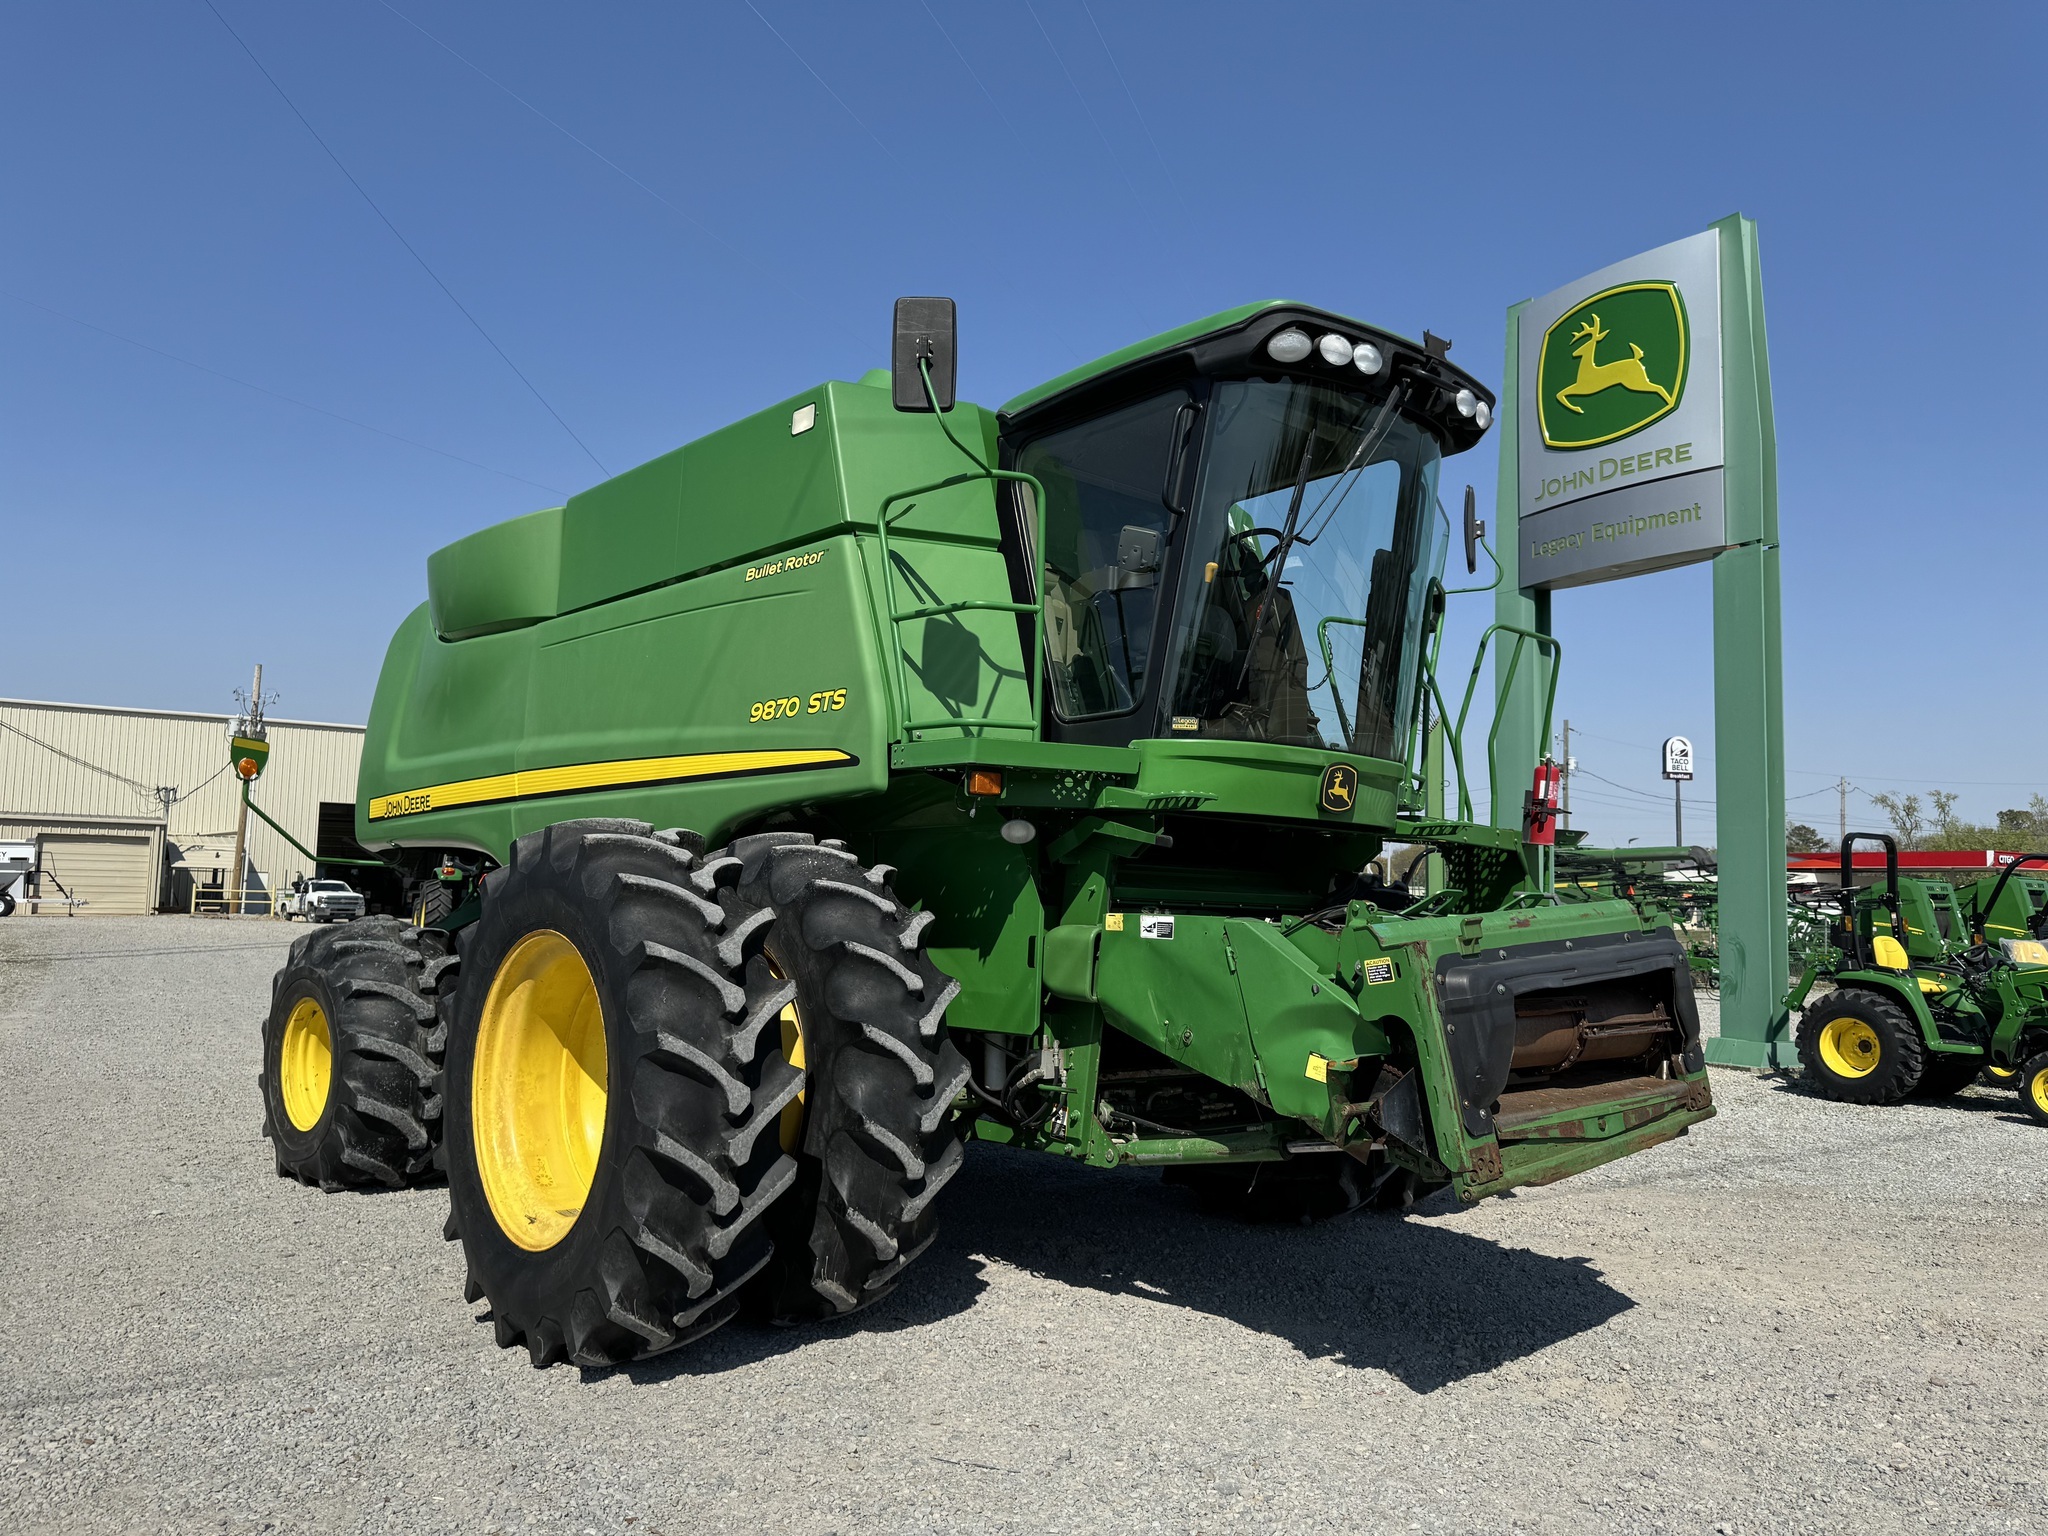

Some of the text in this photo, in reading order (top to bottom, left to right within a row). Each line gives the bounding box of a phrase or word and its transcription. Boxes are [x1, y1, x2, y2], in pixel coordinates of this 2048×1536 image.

[1534, 442, 1693, 501] JOHN DEERE
[1531, 502, 1702, 559] Legacy Equipment
[745, 550, 825, 582] Bullet Rotor
[749, 688, 847, 723] 9870 STS
[384, 794, 431, 816] JOHN DEERE
